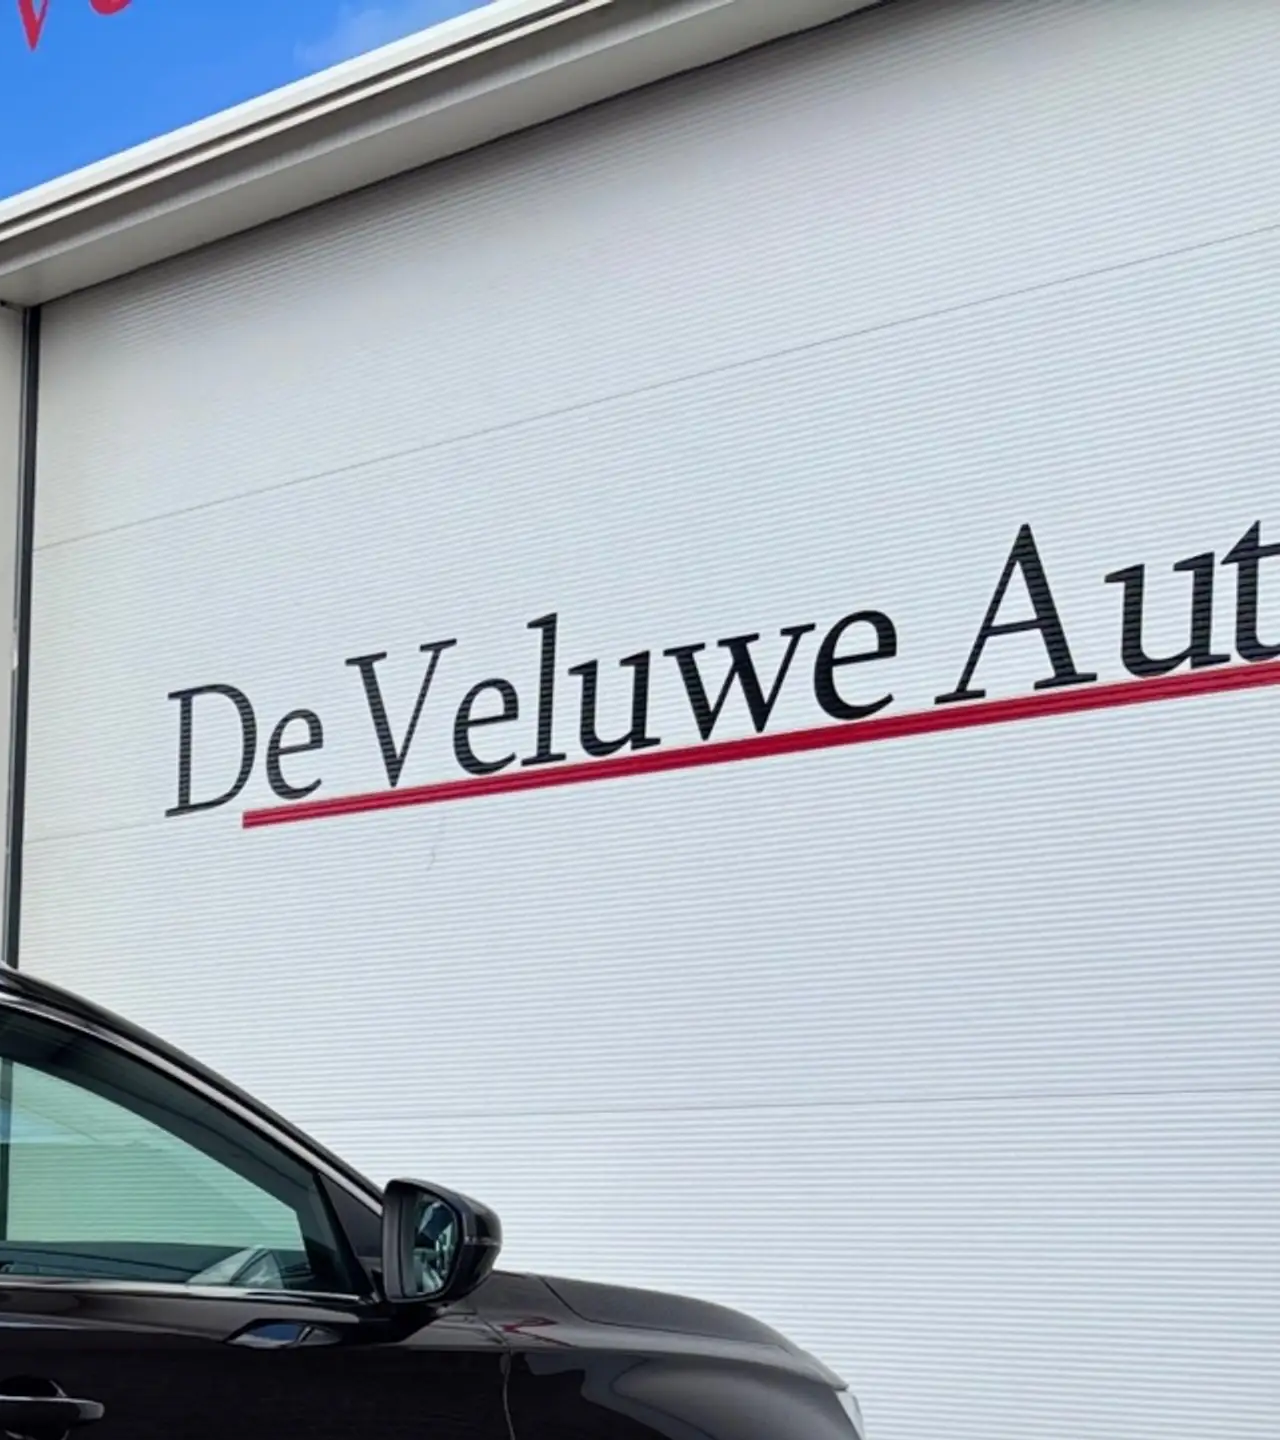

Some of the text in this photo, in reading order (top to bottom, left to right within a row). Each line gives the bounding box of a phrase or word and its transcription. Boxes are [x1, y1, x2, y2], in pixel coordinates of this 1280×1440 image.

[166, 520, 1280, 818] De Veluwe Aut
